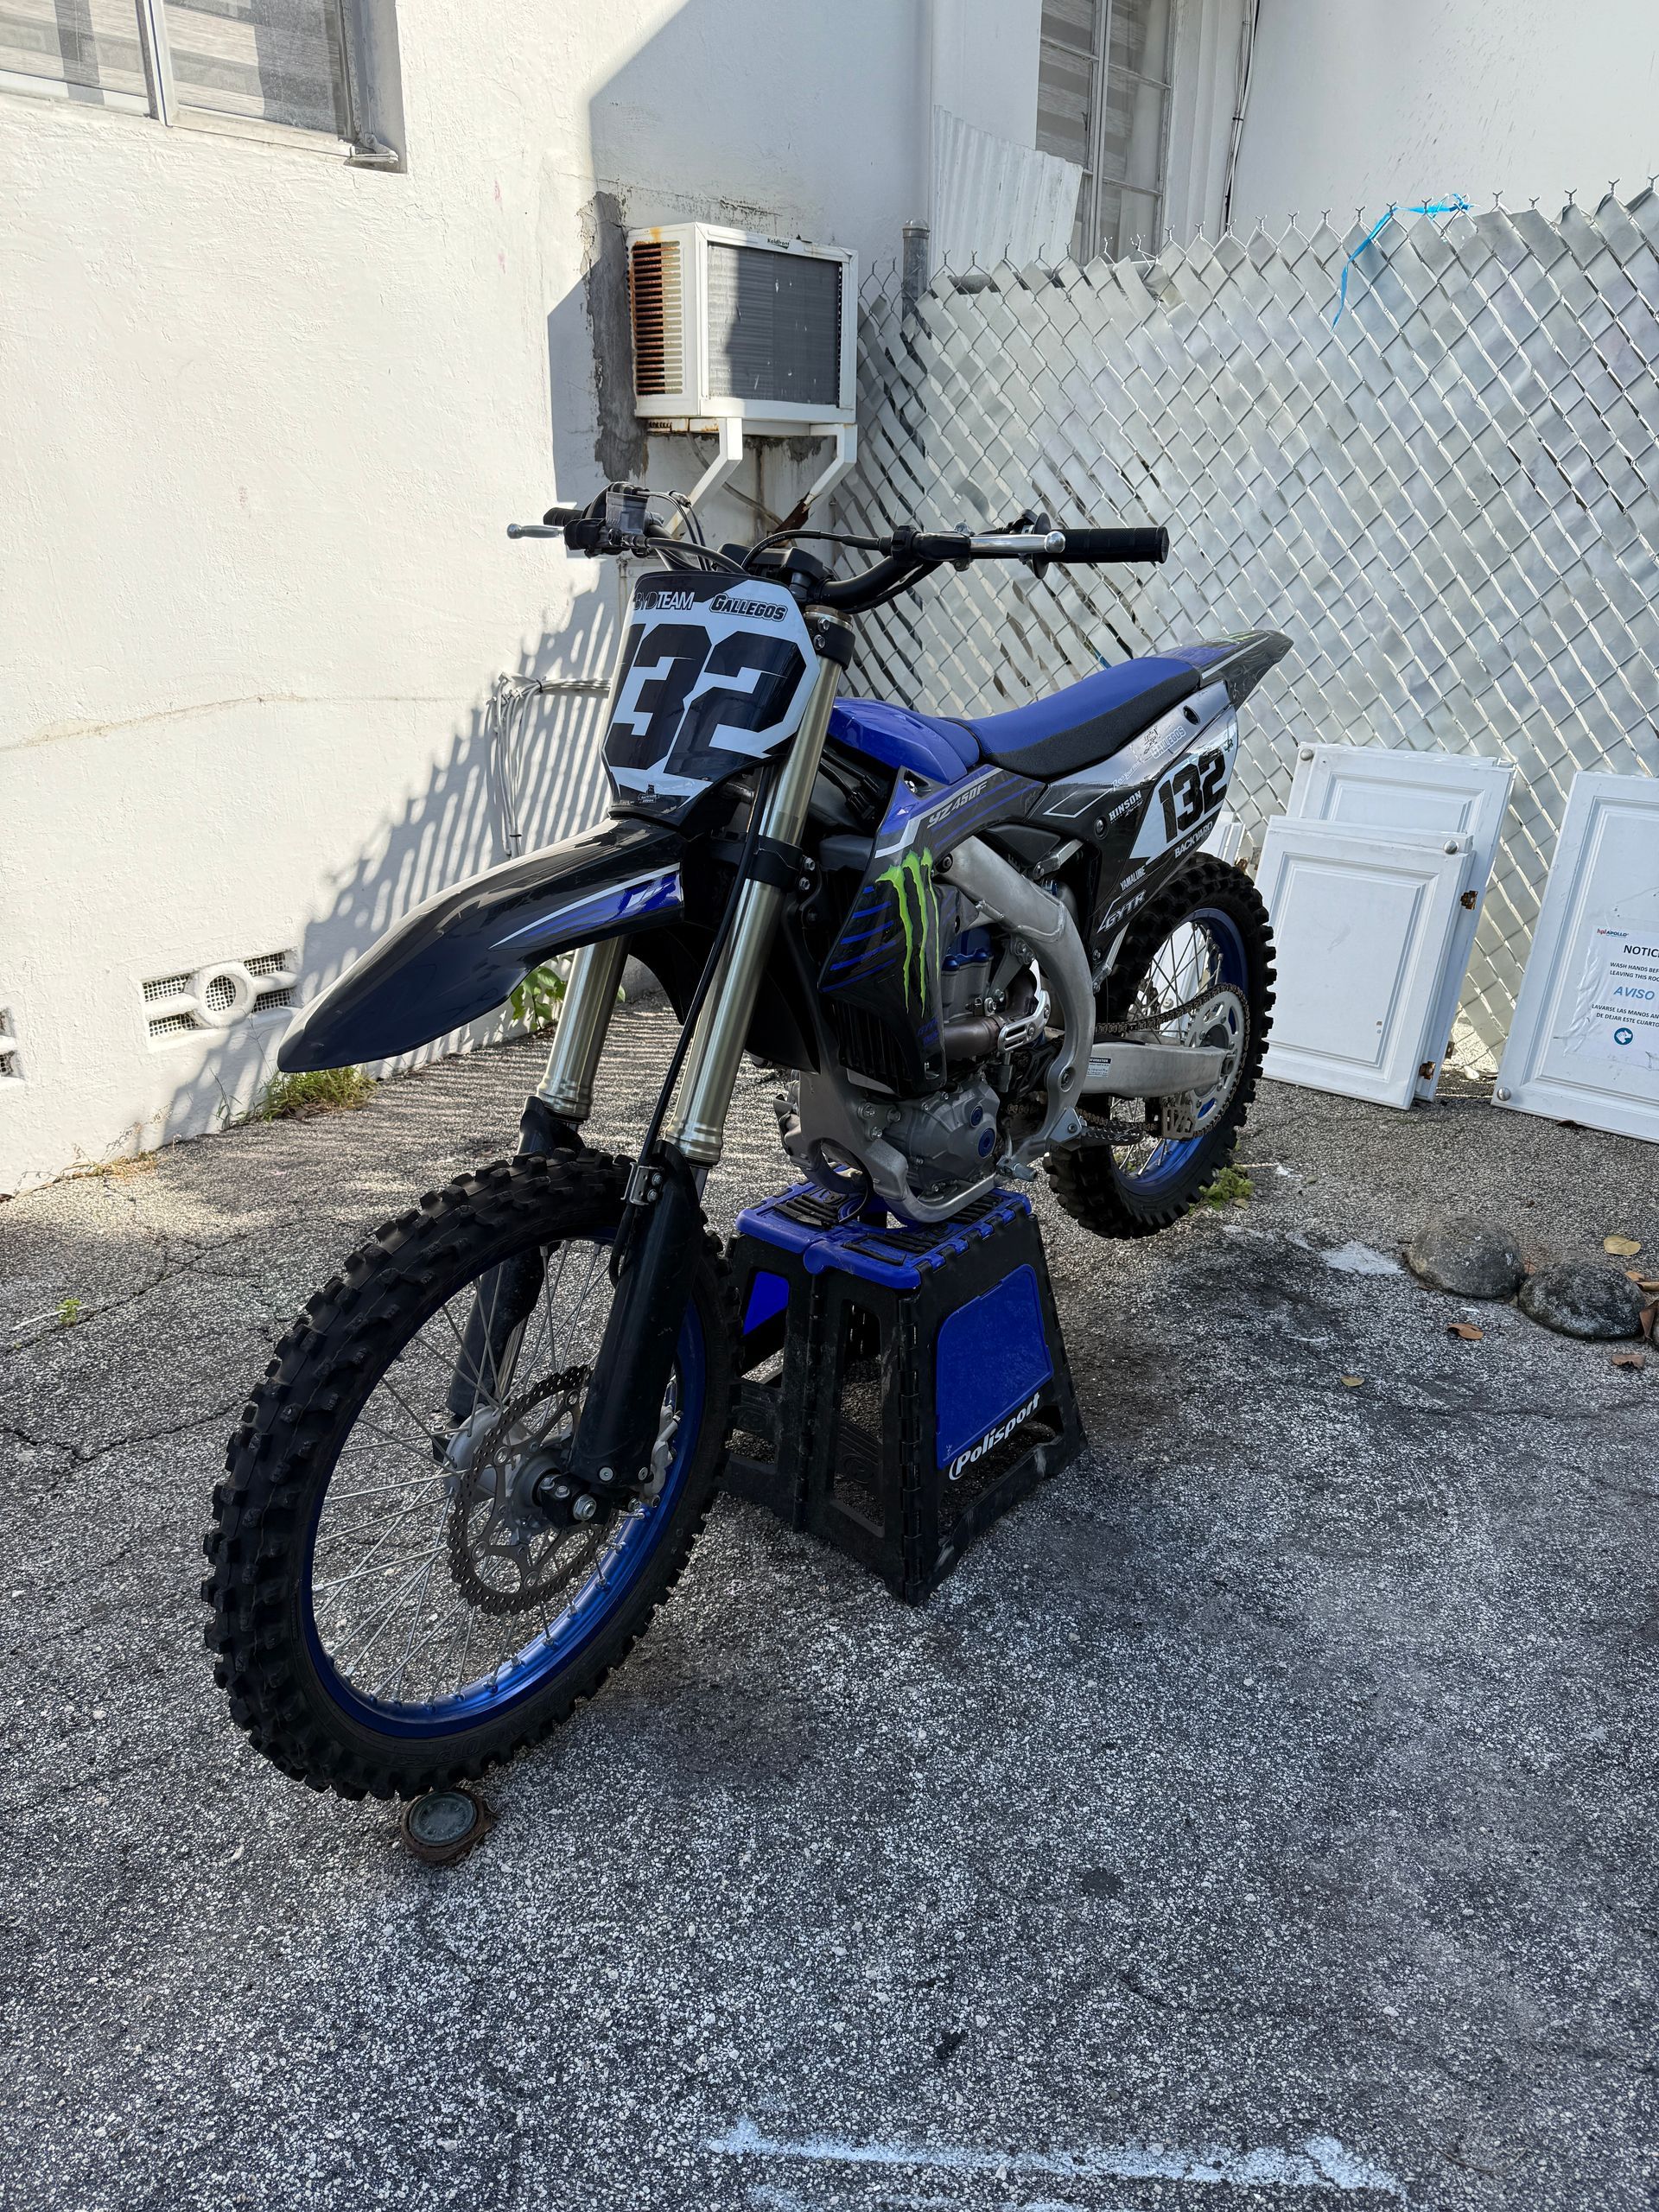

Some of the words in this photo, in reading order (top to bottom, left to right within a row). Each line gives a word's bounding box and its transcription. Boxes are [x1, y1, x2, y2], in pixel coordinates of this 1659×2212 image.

[709, 593, 788, 622] GALLEGOS
[926, 780, 988, 830] YZ450F
[1109, 791, 1142, 822] HINSON
[1159, 747, 1227, 844] 132
[1175, 821, 1213, 859] BACKYARD
[1104, 889, 1147, 932] GYTR
[1623, 944, 1659, 957] NOTIC
[1610, 969, 1634, 978] LEAVING
[1613, 986, 1656, 1001] AVISO
[1592, 1003, 1616, 1013] LAVARSE
[1628, 1009, 1649, 1018] MANOS
[949, 1392, 1040, 1481] Polisport
